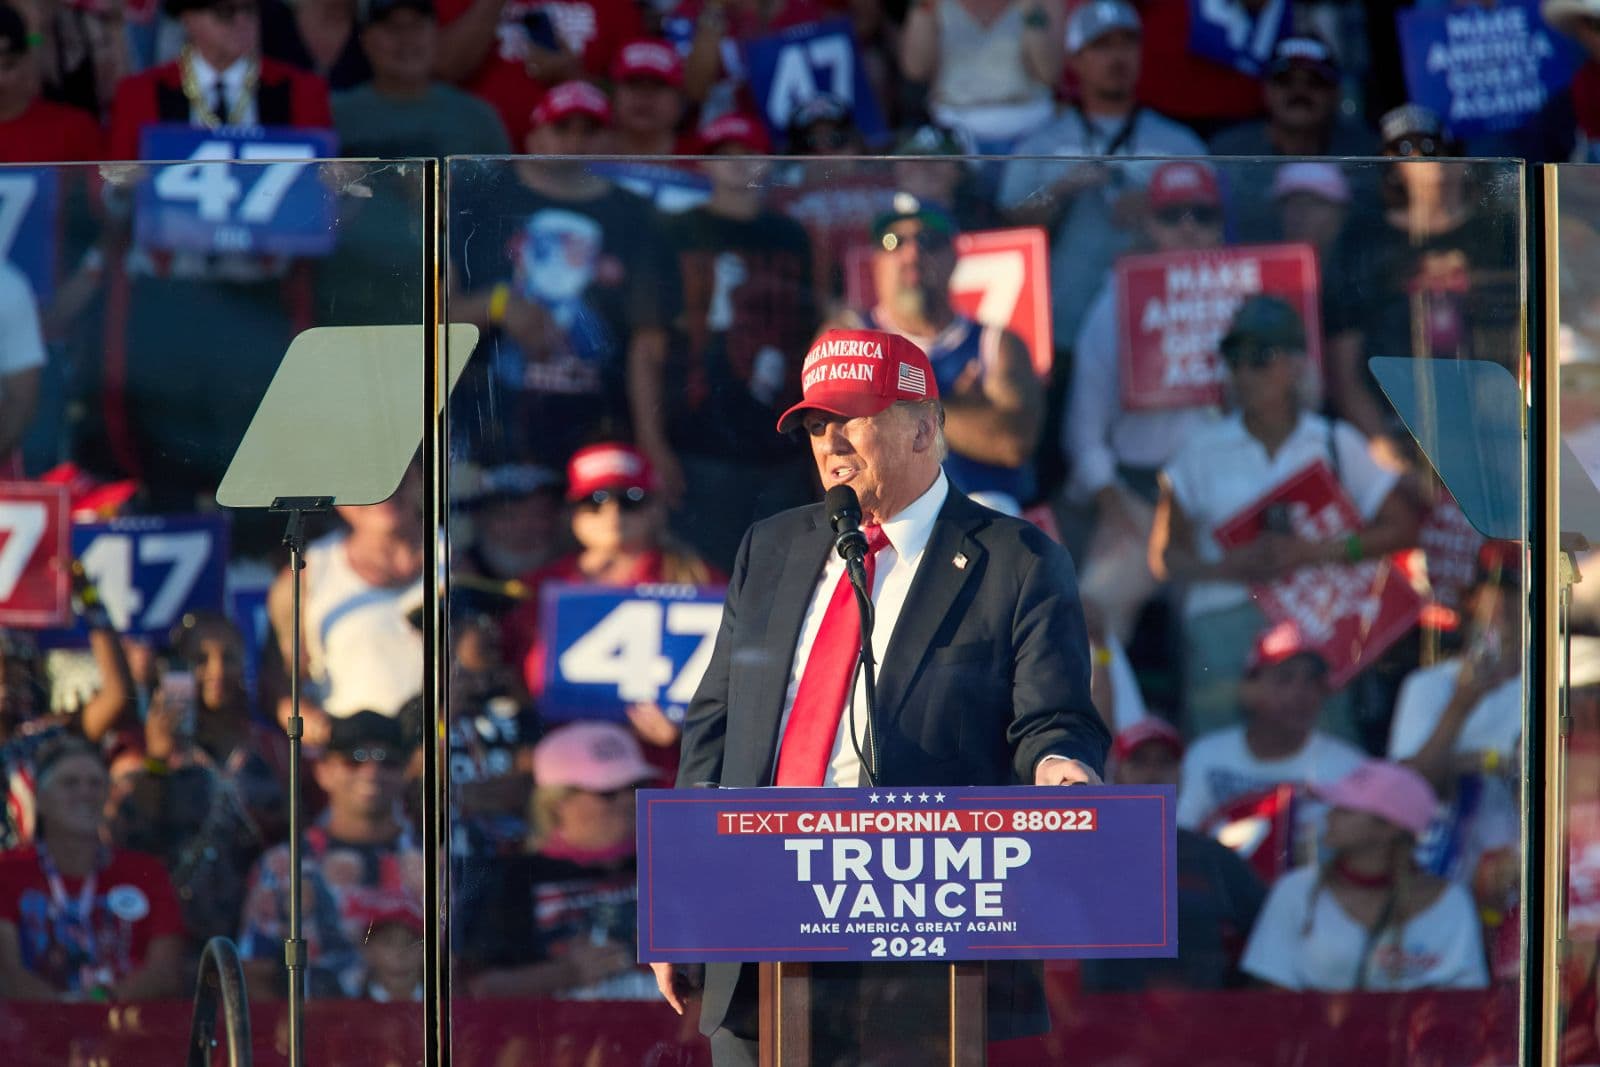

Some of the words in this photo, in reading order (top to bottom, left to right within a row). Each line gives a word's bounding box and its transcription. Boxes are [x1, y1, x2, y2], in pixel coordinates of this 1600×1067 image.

[155, 141, 315, 222] 47
[949, 250, 1025, 328] 7
[820, 340, 883, 360] AMERICA
[829, 362, 874, 382] AGAIN
[0, 502, 47, 602] 7
[82, 531, 213, 632] 47
[559, 600, 724, 702] 47
[722, 813, 789, 833] TEXT
[796, 811, 962, 833] CALIFORNIA
[968, 811, 1004, 832] TO
[1011, 810, 1093, 832] 88022
[784, 837, 1032, 882] TRUMP
[812, 882, 1004, 919] VANCE
[800, 923, 840, 934] MAKE
[845, 922, 910, 934] AMERICA
[914, 922, 962, 933] GREAT
[966, 921, 1017, 932] AGAIN!
[871, 936, 947, 958] 2024
